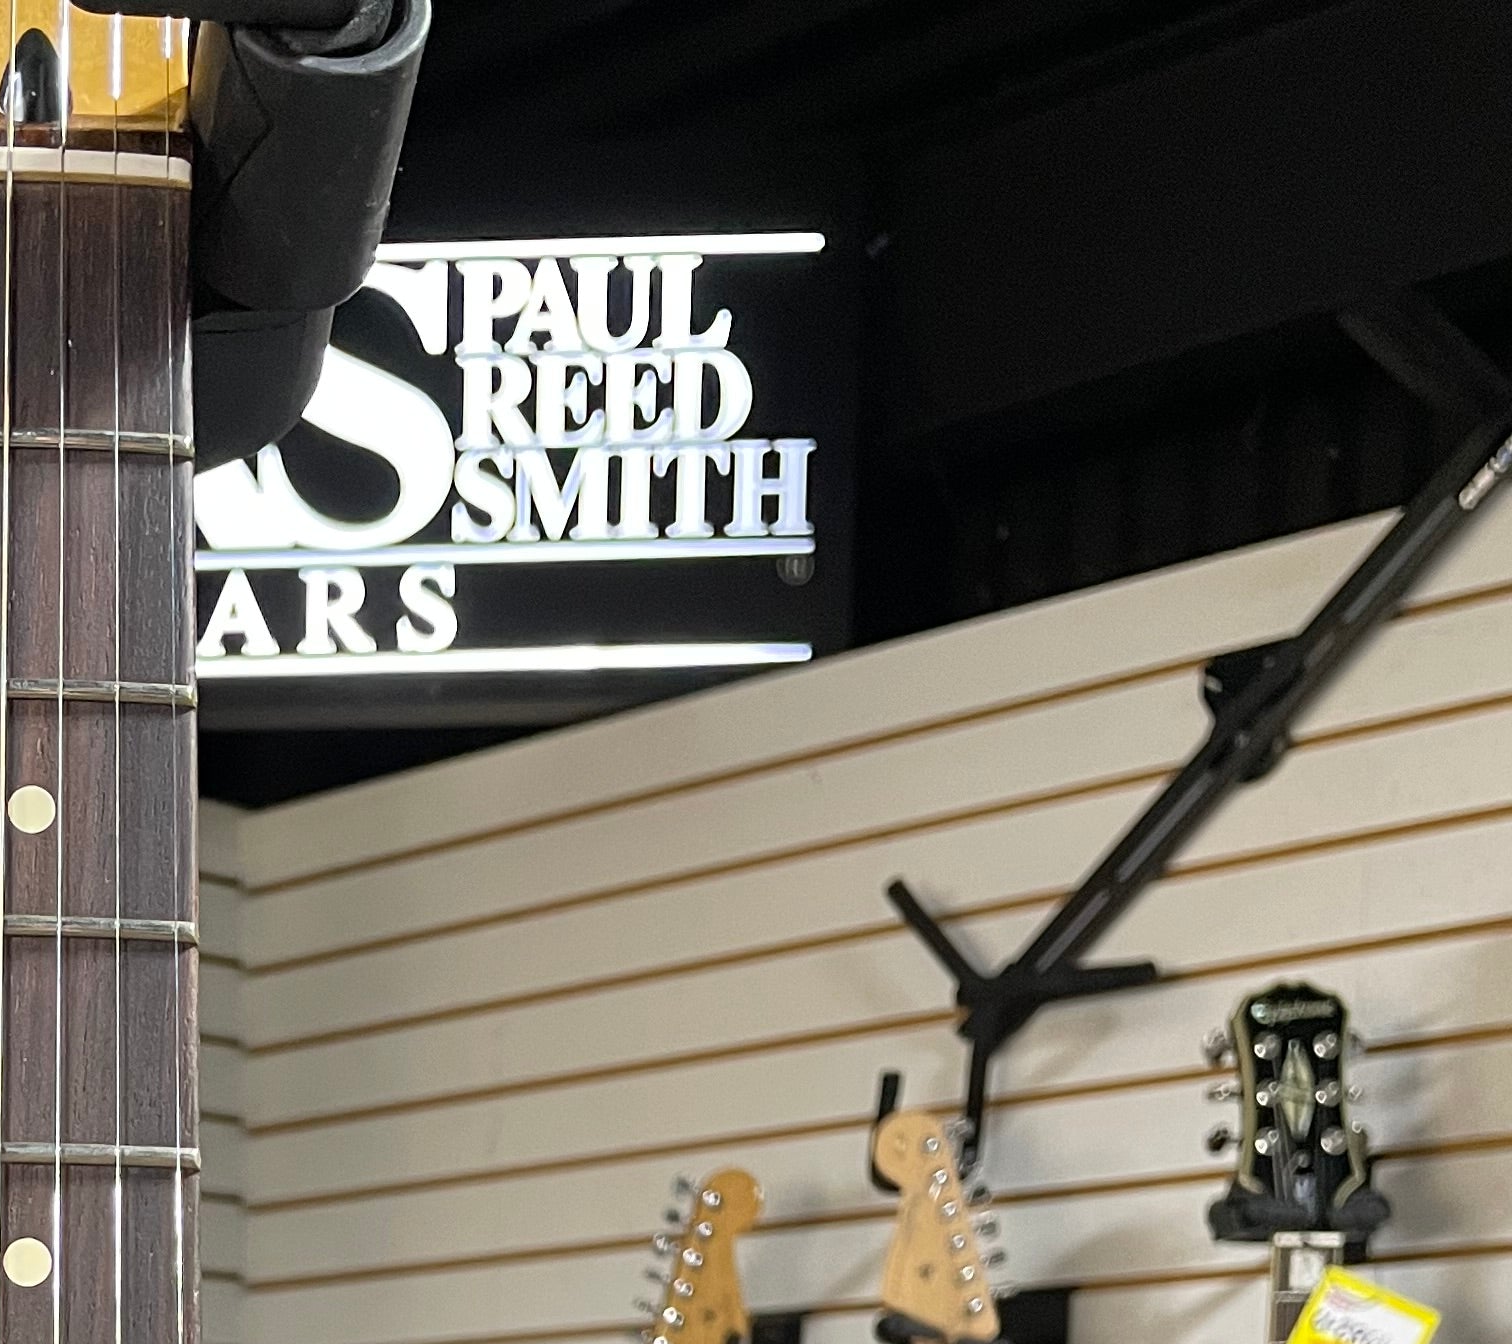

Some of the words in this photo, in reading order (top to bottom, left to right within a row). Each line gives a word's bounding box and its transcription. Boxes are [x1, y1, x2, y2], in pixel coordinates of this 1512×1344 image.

[455, 253, 733, 353] PAUL
[455, 350, 753, 450] REED
[451, 438, 818, 543] SMITH
